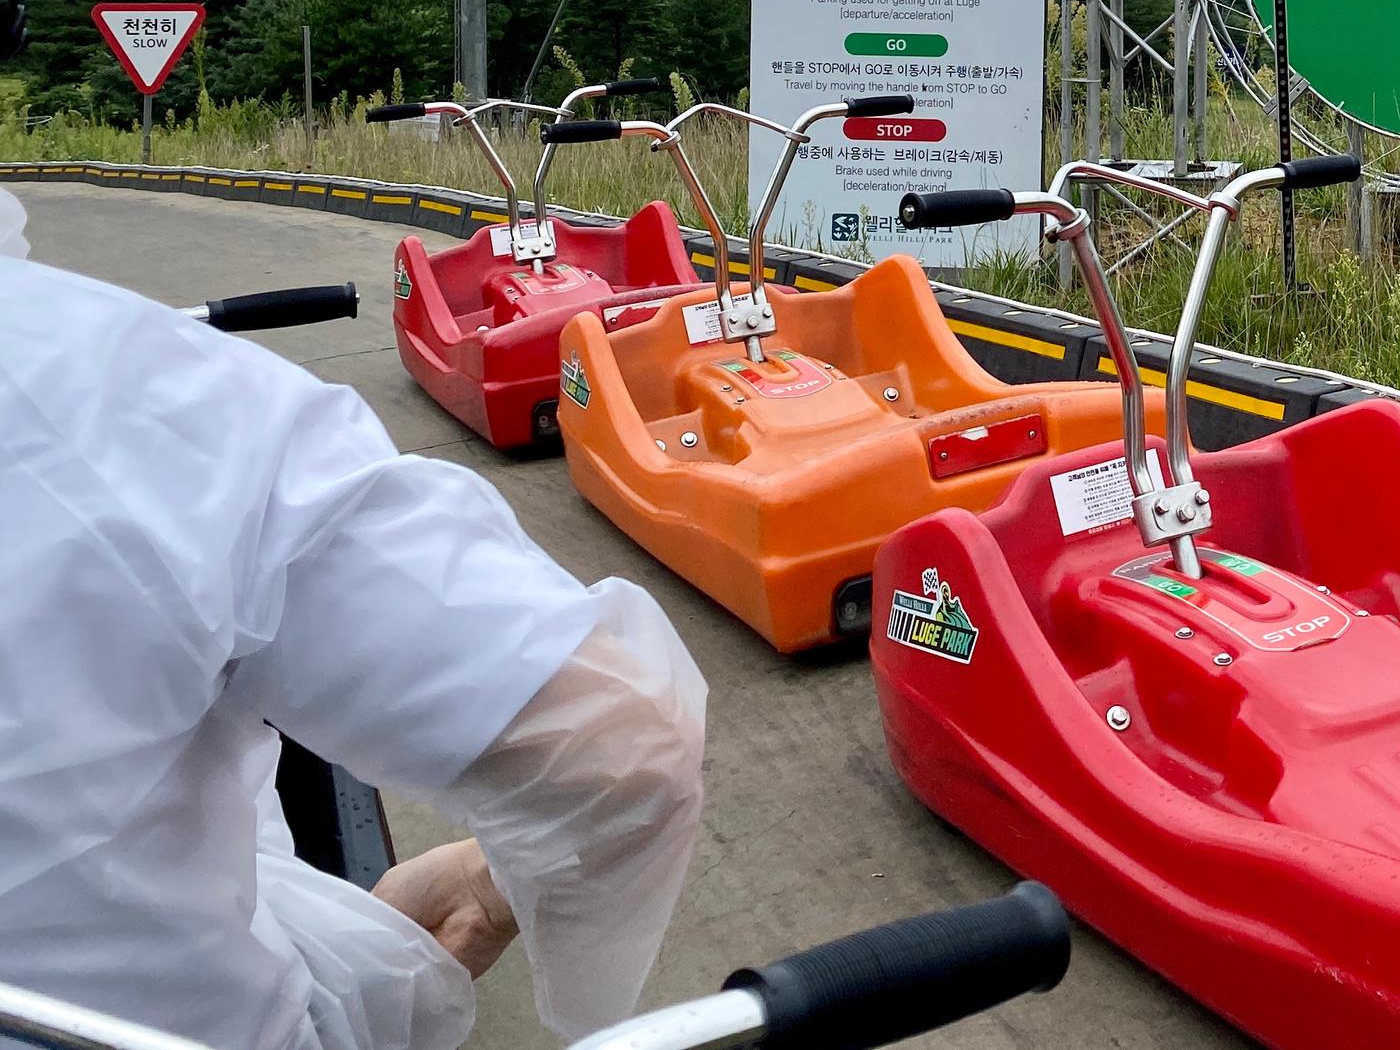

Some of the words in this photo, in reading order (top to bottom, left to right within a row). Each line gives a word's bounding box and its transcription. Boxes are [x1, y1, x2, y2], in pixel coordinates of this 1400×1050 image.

[840, 8, 954, 23] [departure/acceleration]
[122, 18, 177, 36] 천천히
[132, 38, 168, 48] SLOW
[886, 38, 907, 51] GO
[771, 60, 805, 75] 핸들을
[808, 62, 861, 76] STOP에서
[864, 63, 894, 76] GO로
[897, 63, 942, 79] 이동시켜
[945, 64, 1023, 81] 주행(출발/가속)
[784, 78, 813, 90] Travel
[816, 79, 828, 92] by
[830, 80, 865, 94] moving
[868, 81, 884, 92] the
[886, 81, 919, 93] handle
[946, 83, 975, 94] STOP
[978, 85, 988, 95] to
[990, 84, 1007, 95] GO
[876, 124, 913, 137] STOP
[797, 145, 833, 161] 행중에
[837, 147, 886, 162] 사용하는
[893, 148, 1003, 165] 브레이크(감속/제동)
[835, 165, 864, 177] Brake
[866, 166, 890, 177] used
[892, 166, 918, 178] while
[920, 167, 953, 180] driving
[769, 378, 820, 395] STOP
[912, 619, 942, 647] LUGE
[940, 628, 974, 656] PARK
[1261, 614, 1332, 644] STOP
